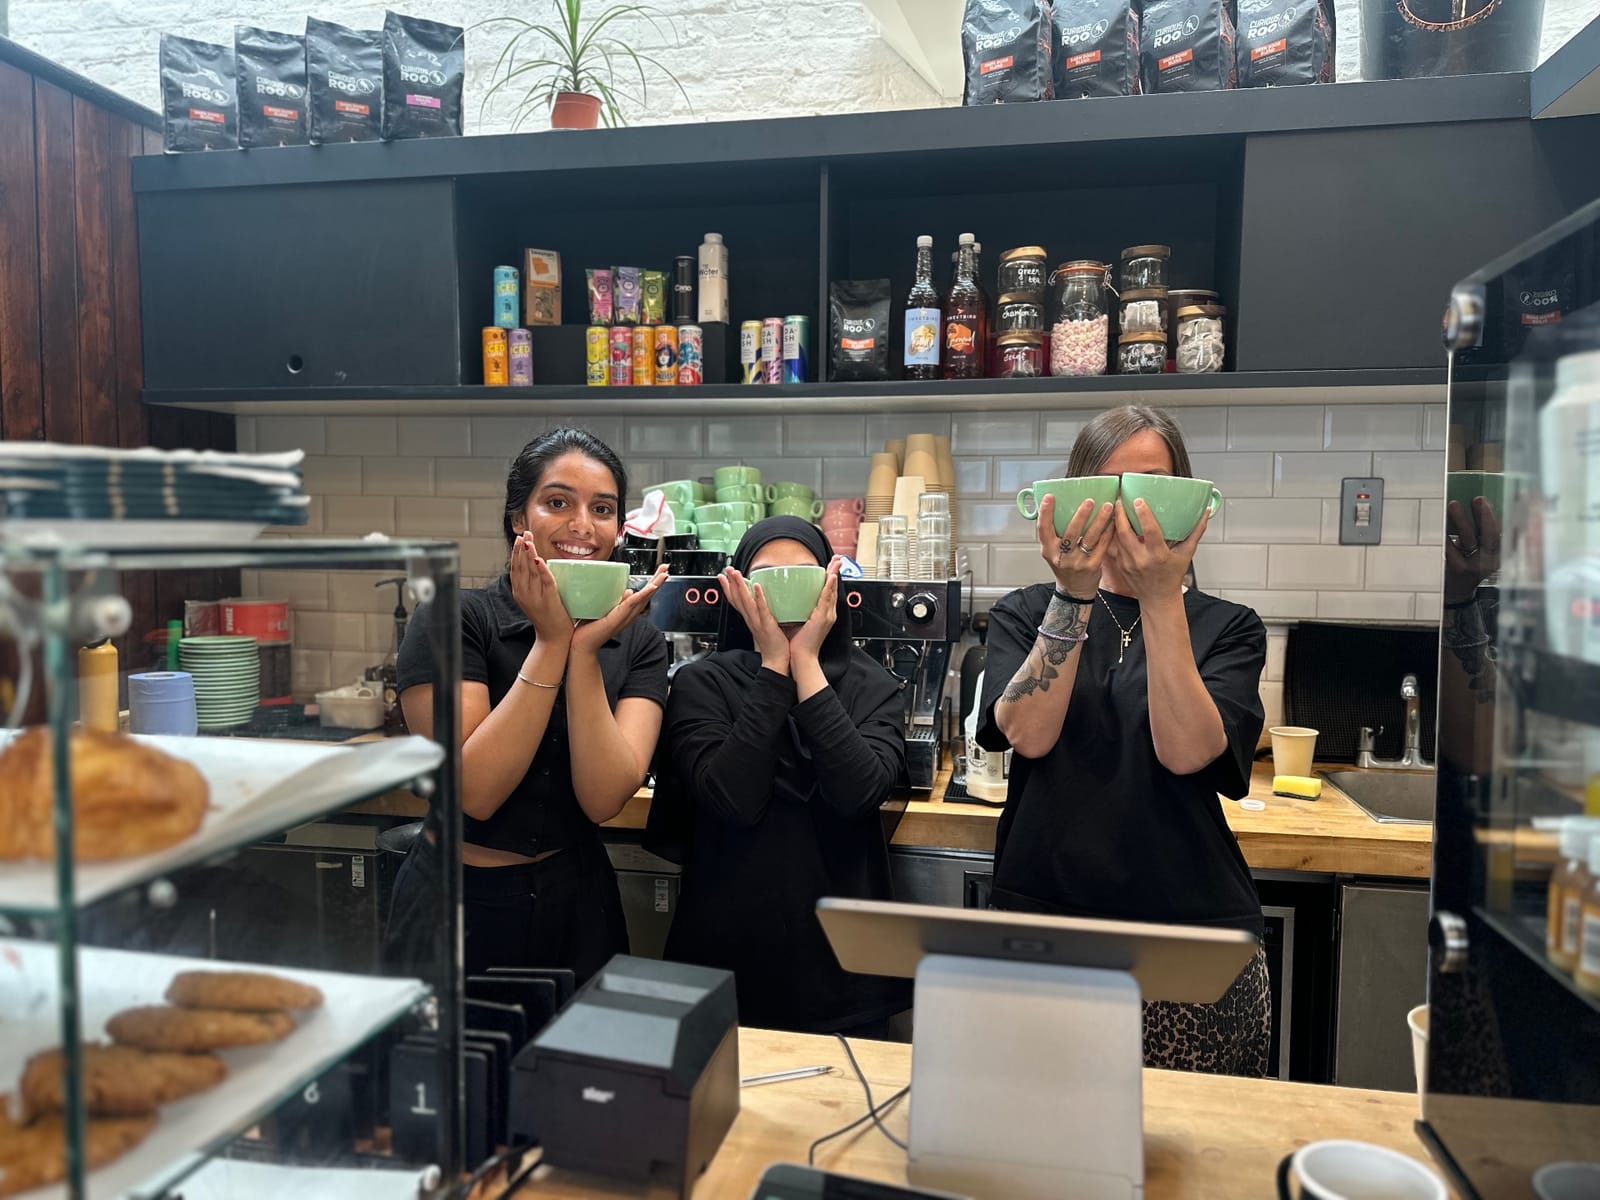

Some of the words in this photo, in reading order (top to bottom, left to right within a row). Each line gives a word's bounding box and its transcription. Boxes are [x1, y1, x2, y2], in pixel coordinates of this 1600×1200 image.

[1249, 13, 1281, 28] CURIOUS
[1062, 23, 1092, 36] CURIOUS
[1155, 21, 1183, 37] CURIOUS
[1248, 23, 1277, 39] ROO
[975, 38, 1003, 52] ROO
[1061, 31, 1090, 46] ROO
[1153, 30, 1181, 48] ROO
[400, 71, 429, 84] ROO
[256, 84, 286, 97] ROO
[328, 79, 357, 92] ROO
[183, 87, 212, 101] ROO
[1018, 268, 1040, 281] green
[843, 324, 863, 333] ROO
[303, 1081, 320, 1104] 6
[410, 1082, 438, 1115] 1
